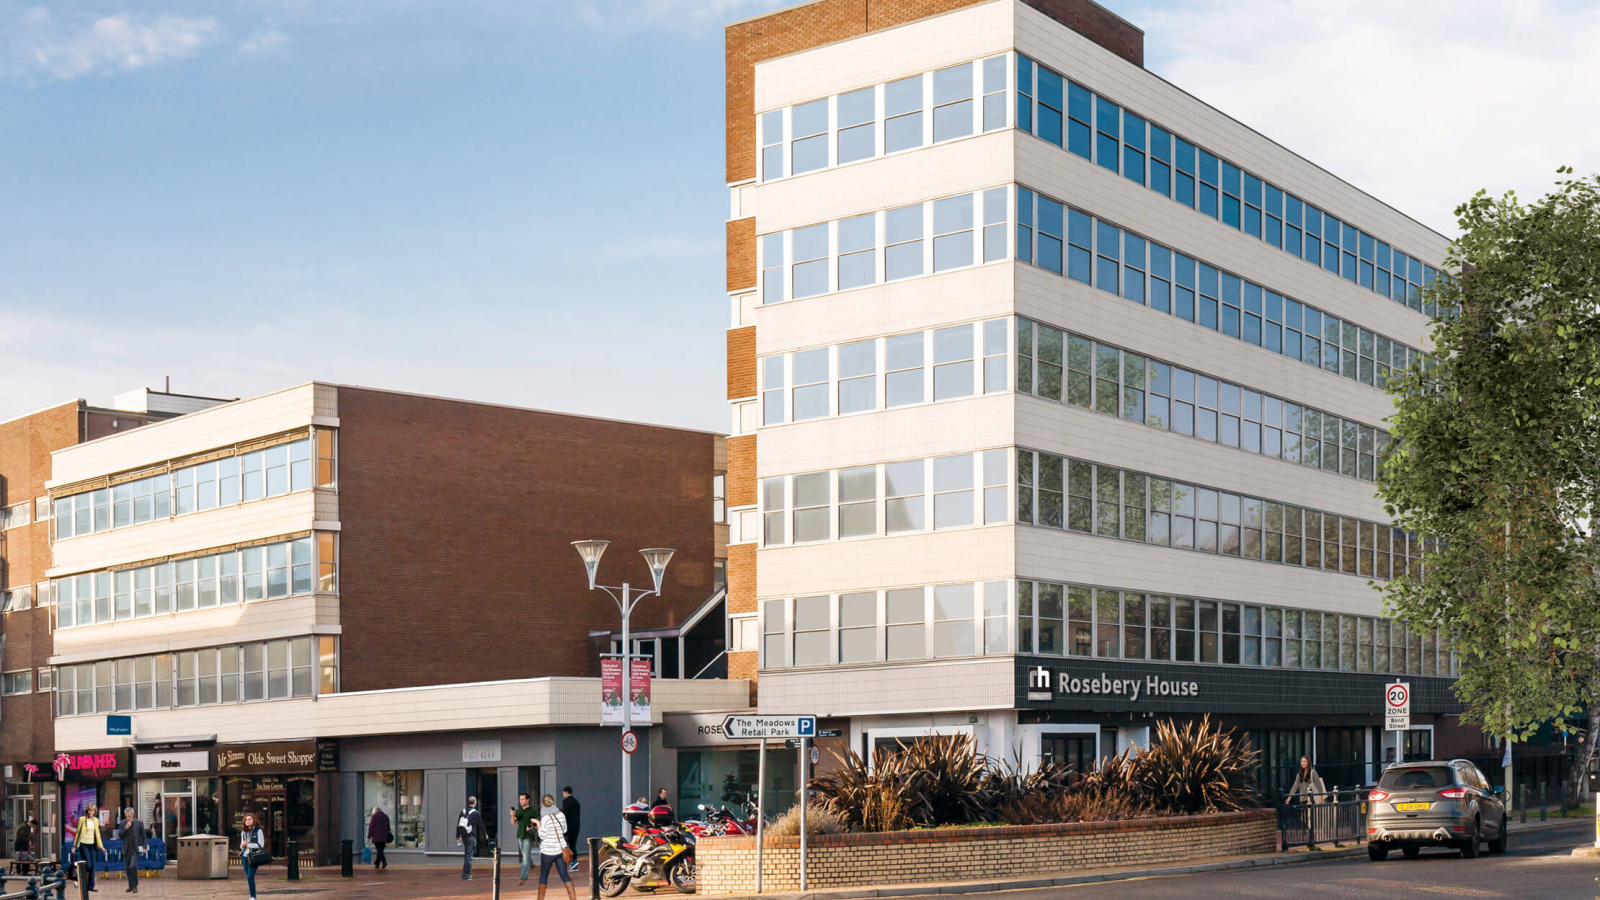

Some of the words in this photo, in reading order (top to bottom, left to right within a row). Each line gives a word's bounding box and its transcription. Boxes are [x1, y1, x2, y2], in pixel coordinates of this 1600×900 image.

[1059, 672, 1141, 701] Rosebery
[1146, 675, 1199, 696] House
[1390, 691, 1405, 701] 20
[1387, 707, 1407, 715] ZONE
[698, 725, 722, 735] ROSE
[736, 719, 752, 727] The
[756, 719, 796, 727] Meadows
[801, 719, 811, 733] P
[741, 728, 767, 736] Retail
[771, 728, 790, 736] Park
[217, 752, 227, 771] Mr
[227, 750, 245, 763] Simms
[248, 752, 265, 765] Olde
[266, 752, 286, 764] Sweet
[287, 751, 314, 765] Shoppe
